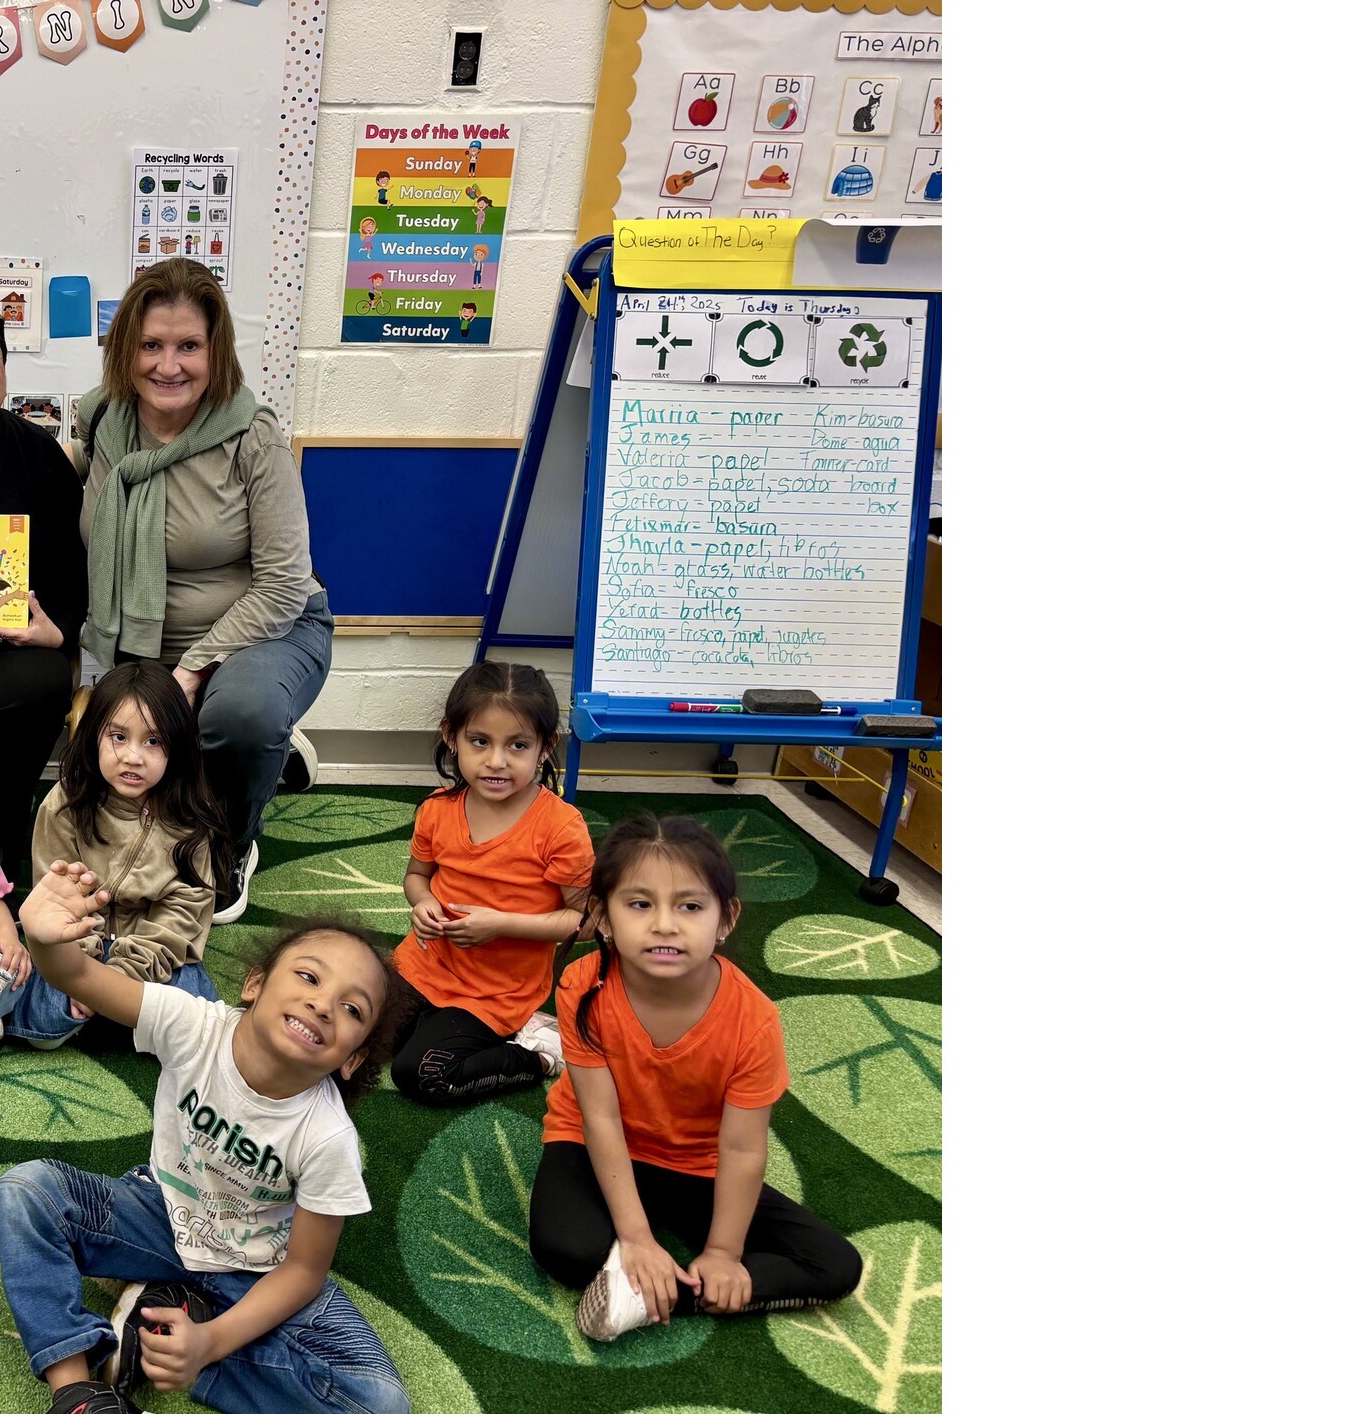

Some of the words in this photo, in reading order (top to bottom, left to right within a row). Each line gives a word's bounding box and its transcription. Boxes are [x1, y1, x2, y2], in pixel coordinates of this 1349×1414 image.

[843, 36, 884, 52] The
[891, 36, 942, 56] Alph
[693, 75, 721, 90] Aa
[775, 78, 801, 93] Bb
[858, 81, 884, 96] Cc
[365, 124, 407, 143] Days
[411, 124, 430, 140] of
[432, 124, 459, 140] the
[463, 124, 510, 140] Week
[145, 153, 190, 164] Recycling
[193, 153, 224, 163] Words
[683, 145, 711, 164] Gg
[763, 145, 788, 160] Hh
[405, 156, 463, 174] Sunday
[400, 186, 461, 203] Monday
[396, 214, 459, 231] Tuesday
[618, 224, 682, 249] Question
[688, 235, 699, 247] of
[700, 226, 732, 247] The
[381, 242, 468, 258] Wednesday
[388, 269, 457, 286] Thursday
[395, 297, 442, 313] Friday
[620, 295, 650, 312] April
[690, 296, 722, 310] 2025
[737, 296, 778, 314] Today
[784, 299, 794, 312] is
[382, 323, 449, 340] Saturday
[850, 377, 869, 385] recycle
[730, 410, 783, 440] paper
[619, 422, 692, 450] James
[617, 442, 687, 466] Valeria
[863, 437, 900, 457] agua
[619, 466, 689, 490] Jacob
[850, 474, 897, 493] board
[867, 498, 899, 517] box
[716, 516, 777, 535] basura
[606, 552, 654, 575] Noah
[744, 562, 791, 579] water
[607, 574, 656, 600] Sofia
[687, 579, 738, 599] fresco
[601, 618, 665, 648] Sammy
[601, 641, 671, 672] Santiago
[204, 1162, 227, 1179] SINCE
